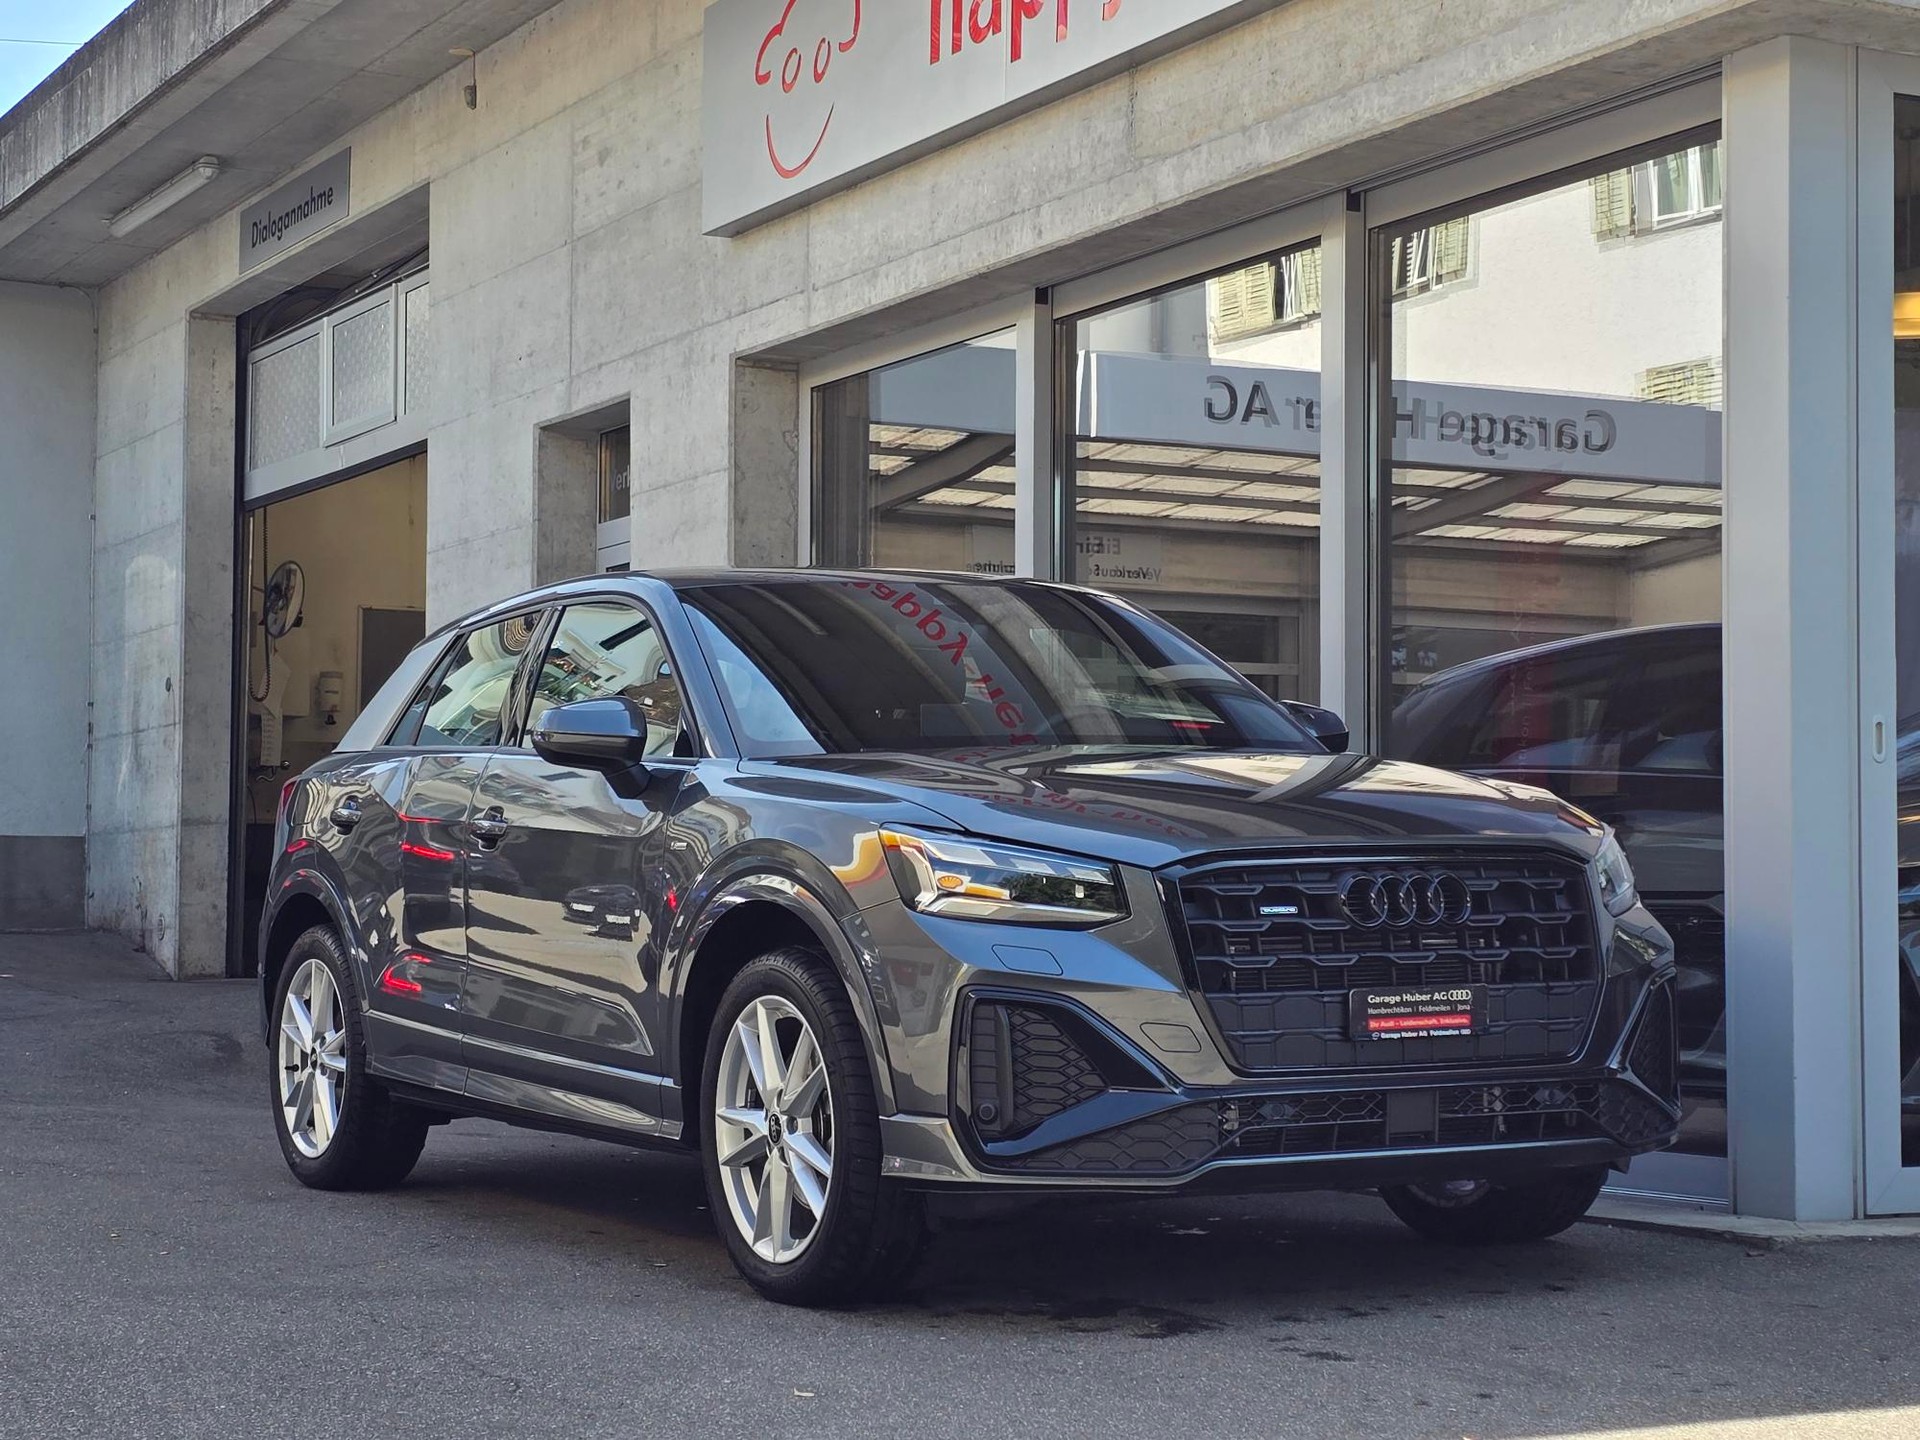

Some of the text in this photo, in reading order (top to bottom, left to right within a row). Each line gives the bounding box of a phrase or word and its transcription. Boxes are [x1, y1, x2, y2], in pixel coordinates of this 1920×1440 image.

[251, 185, 334, 249] Dialogannahme
[1367, 991, 1448, 1005] Garage Huber AG
[1418, 1004, 1451, 1012] Feldmeilen
[1457, 1003, 1471, 1011] Jona
